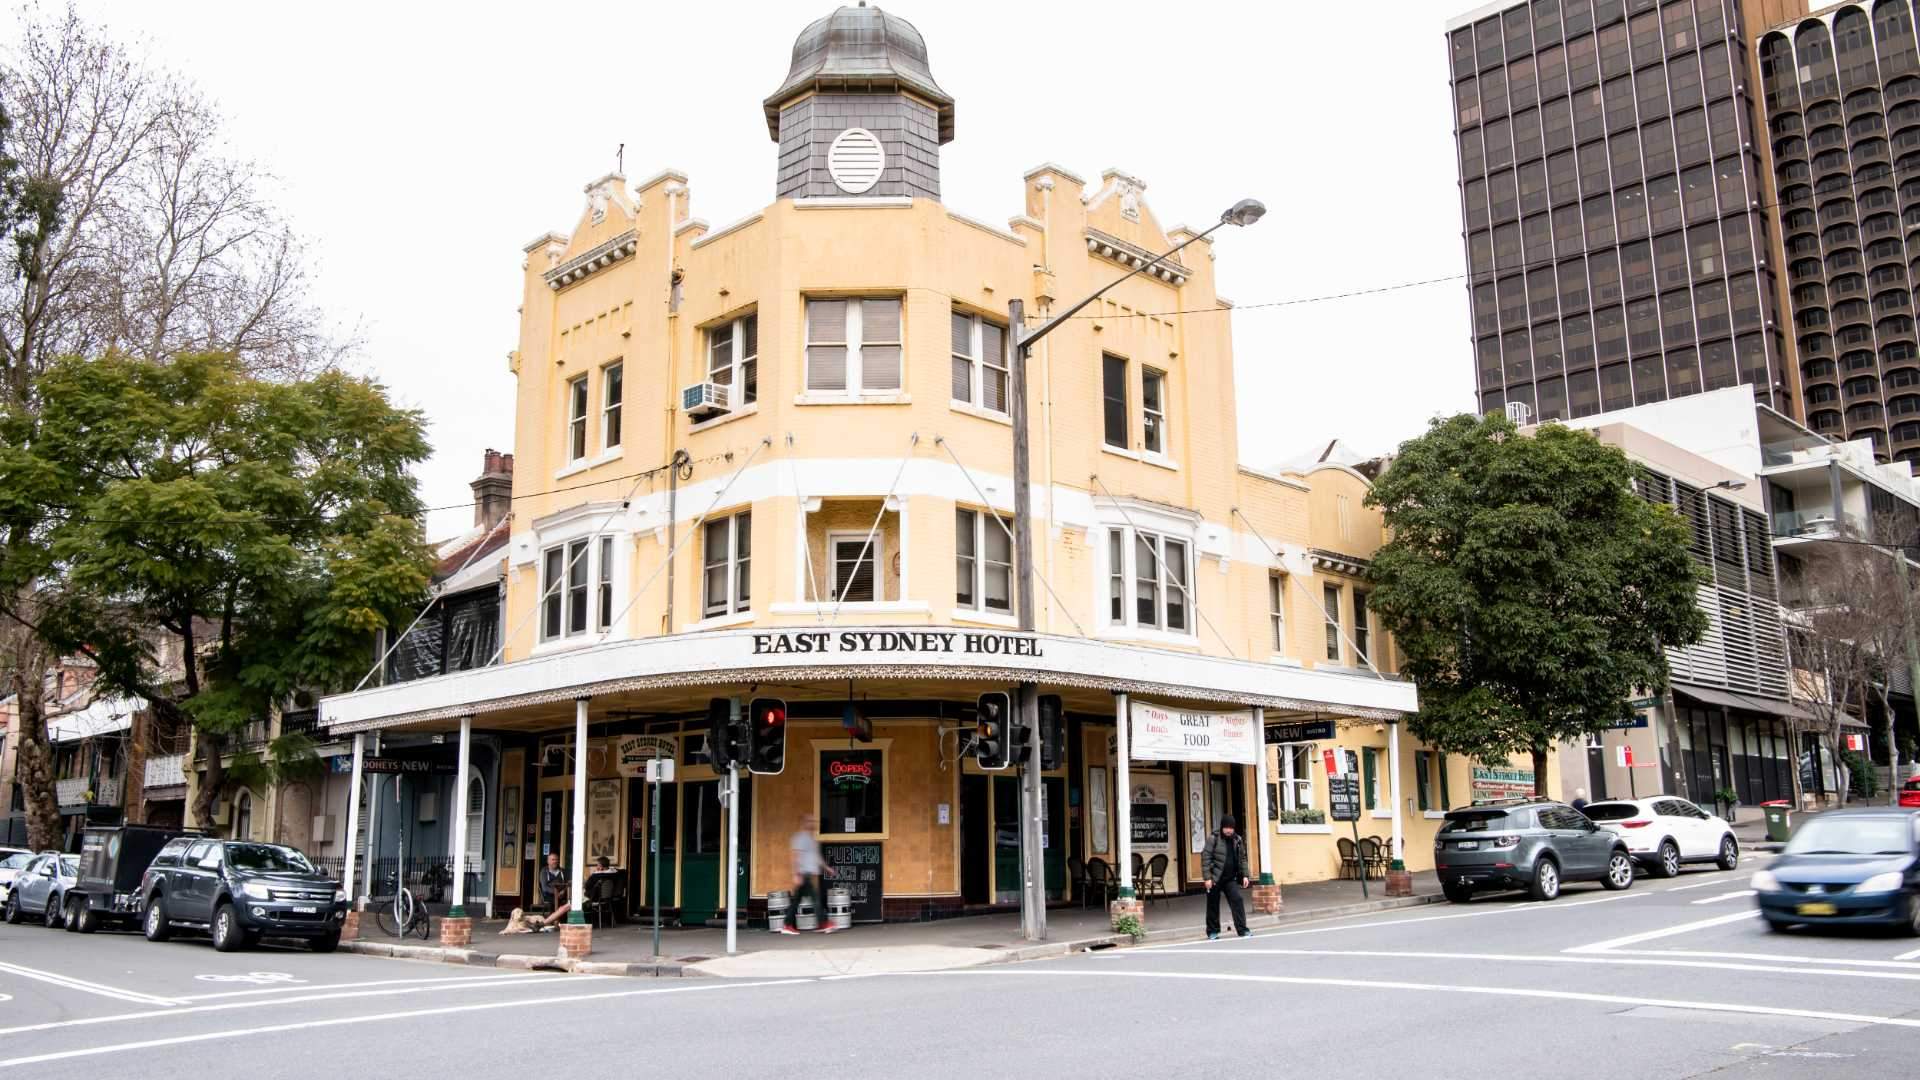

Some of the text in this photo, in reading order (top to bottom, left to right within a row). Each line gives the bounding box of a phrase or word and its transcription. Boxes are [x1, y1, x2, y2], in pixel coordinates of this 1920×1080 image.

[752, 632, 1043, 656] EAST SYDNEY HOTEL
[1179, 714, 1210, 727] GREAT
[1183, 733, 1210, 747] FOOD
[1273, 728, 1300, 740] NEW
[401, 761, 430, 771] NEW
[826, 847, 880, 864] PUB OPEN
